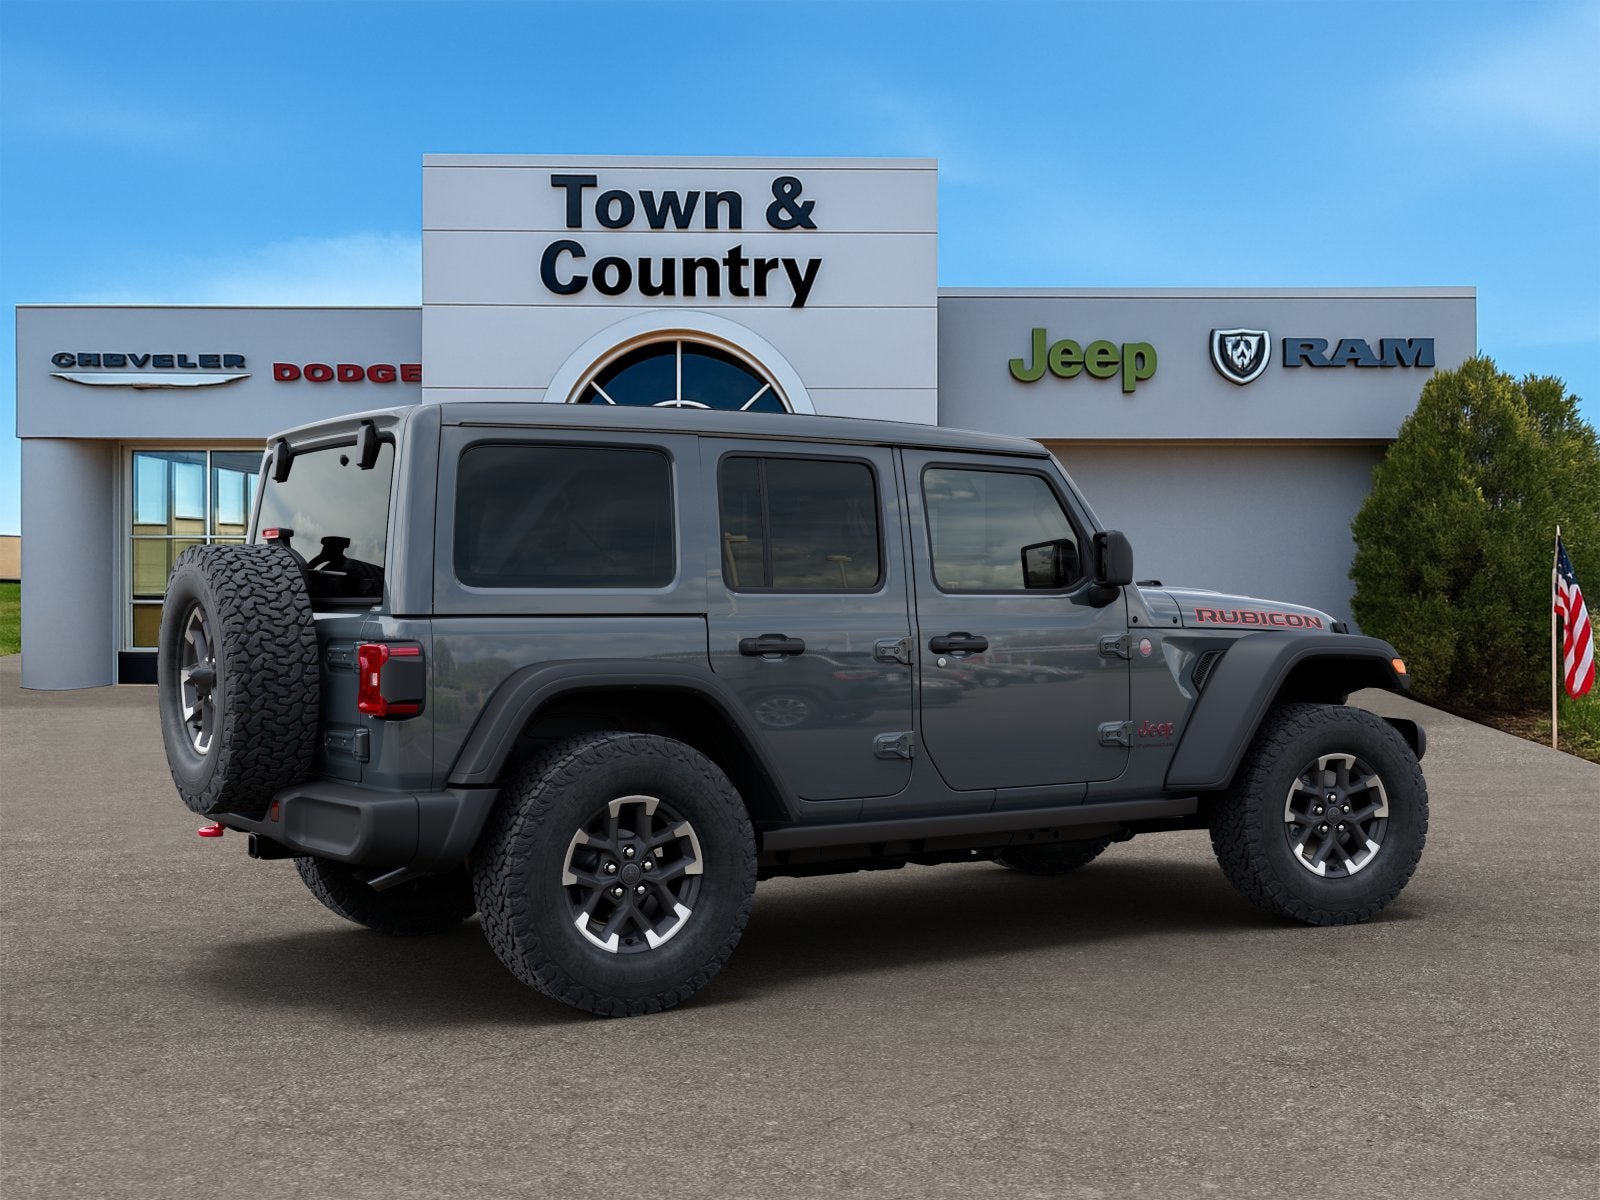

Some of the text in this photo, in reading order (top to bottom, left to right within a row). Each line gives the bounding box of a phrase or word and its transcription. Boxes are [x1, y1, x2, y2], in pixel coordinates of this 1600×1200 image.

[550, 174, 818, 230] Town &
[540, 239, 822, 308] Country
[1009, 327, 1157, 392] Jeep
[1282, 337, 1435, 368] RAM
[273, 362, 422, 383] DODGE
[1195, 608, 1324, 629] RUBICON
[1137, 720, 1174, 739] Jeep
